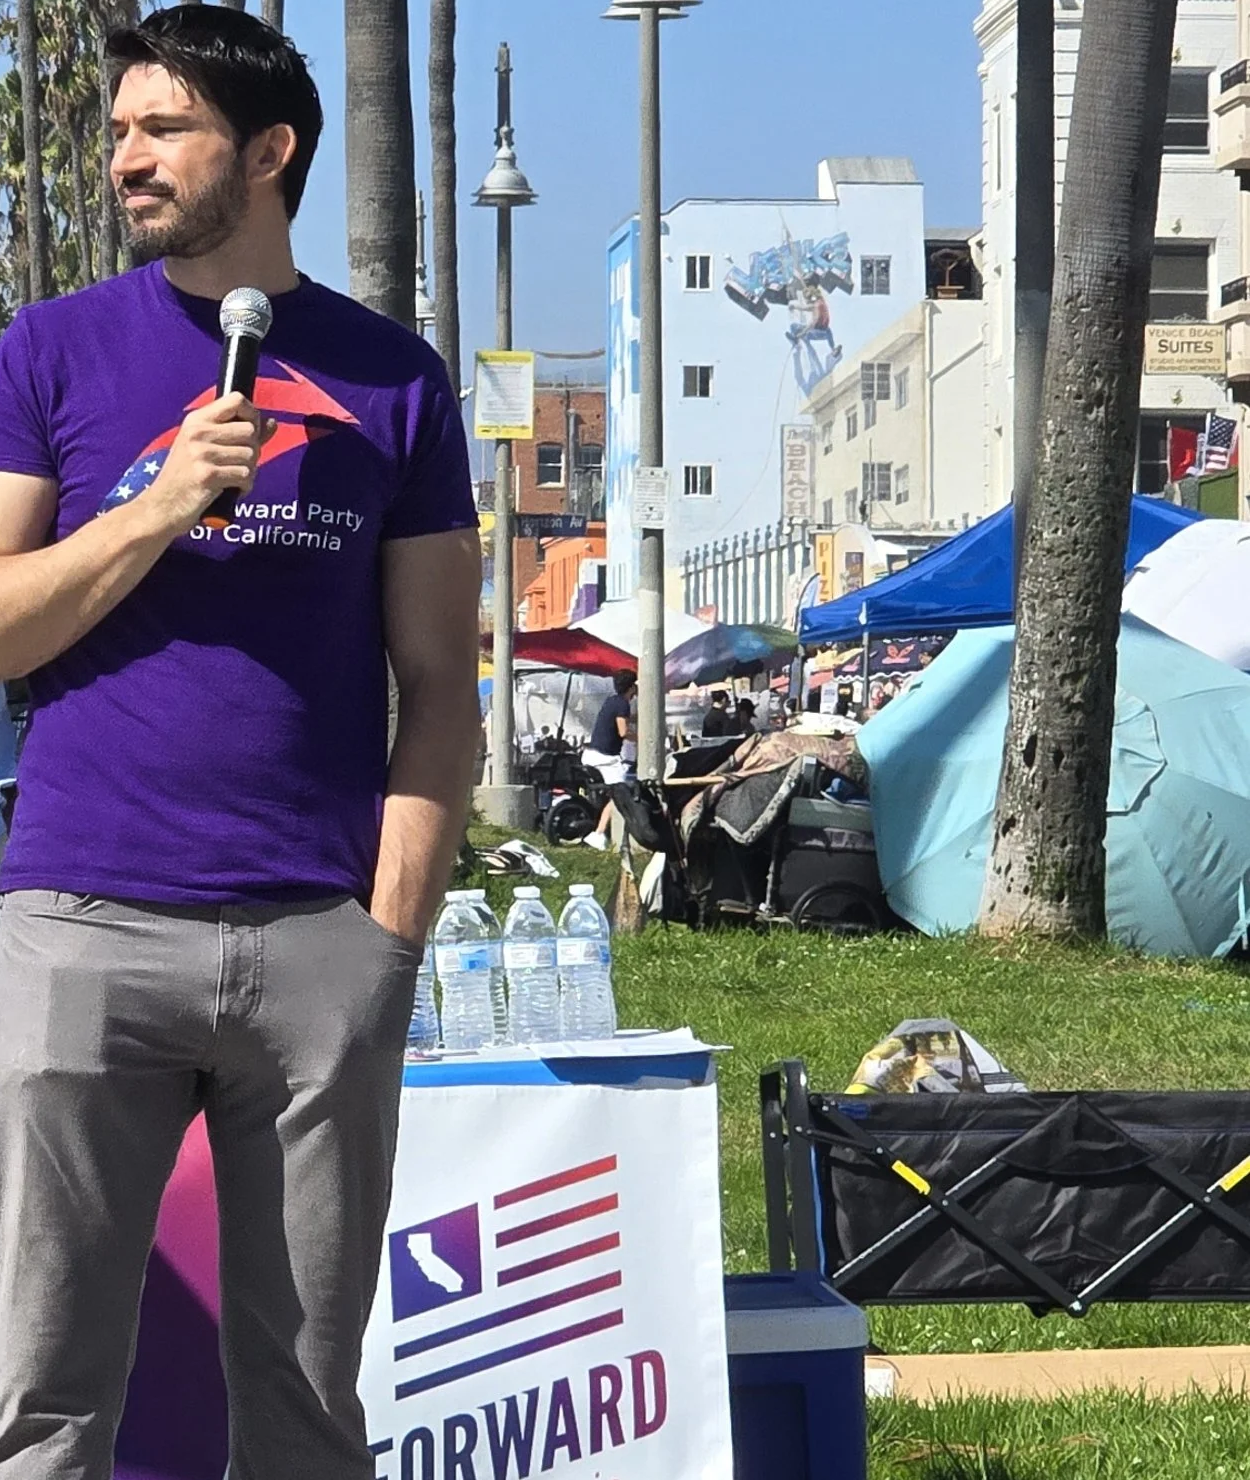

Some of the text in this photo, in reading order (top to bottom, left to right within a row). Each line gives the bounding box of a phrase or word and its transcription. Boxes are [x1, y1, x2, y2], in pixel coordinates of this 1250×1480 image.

[1148, 327, 1223, 338] VENICE BEACH
[1158, 339, 1213, 354] SUITES
[786, 443, 808, 516] BEACH
[234, 500, 365, 532] ward Party
[190, 524, 342, 551] of California
[819, 542, 829, 602] PIZ
